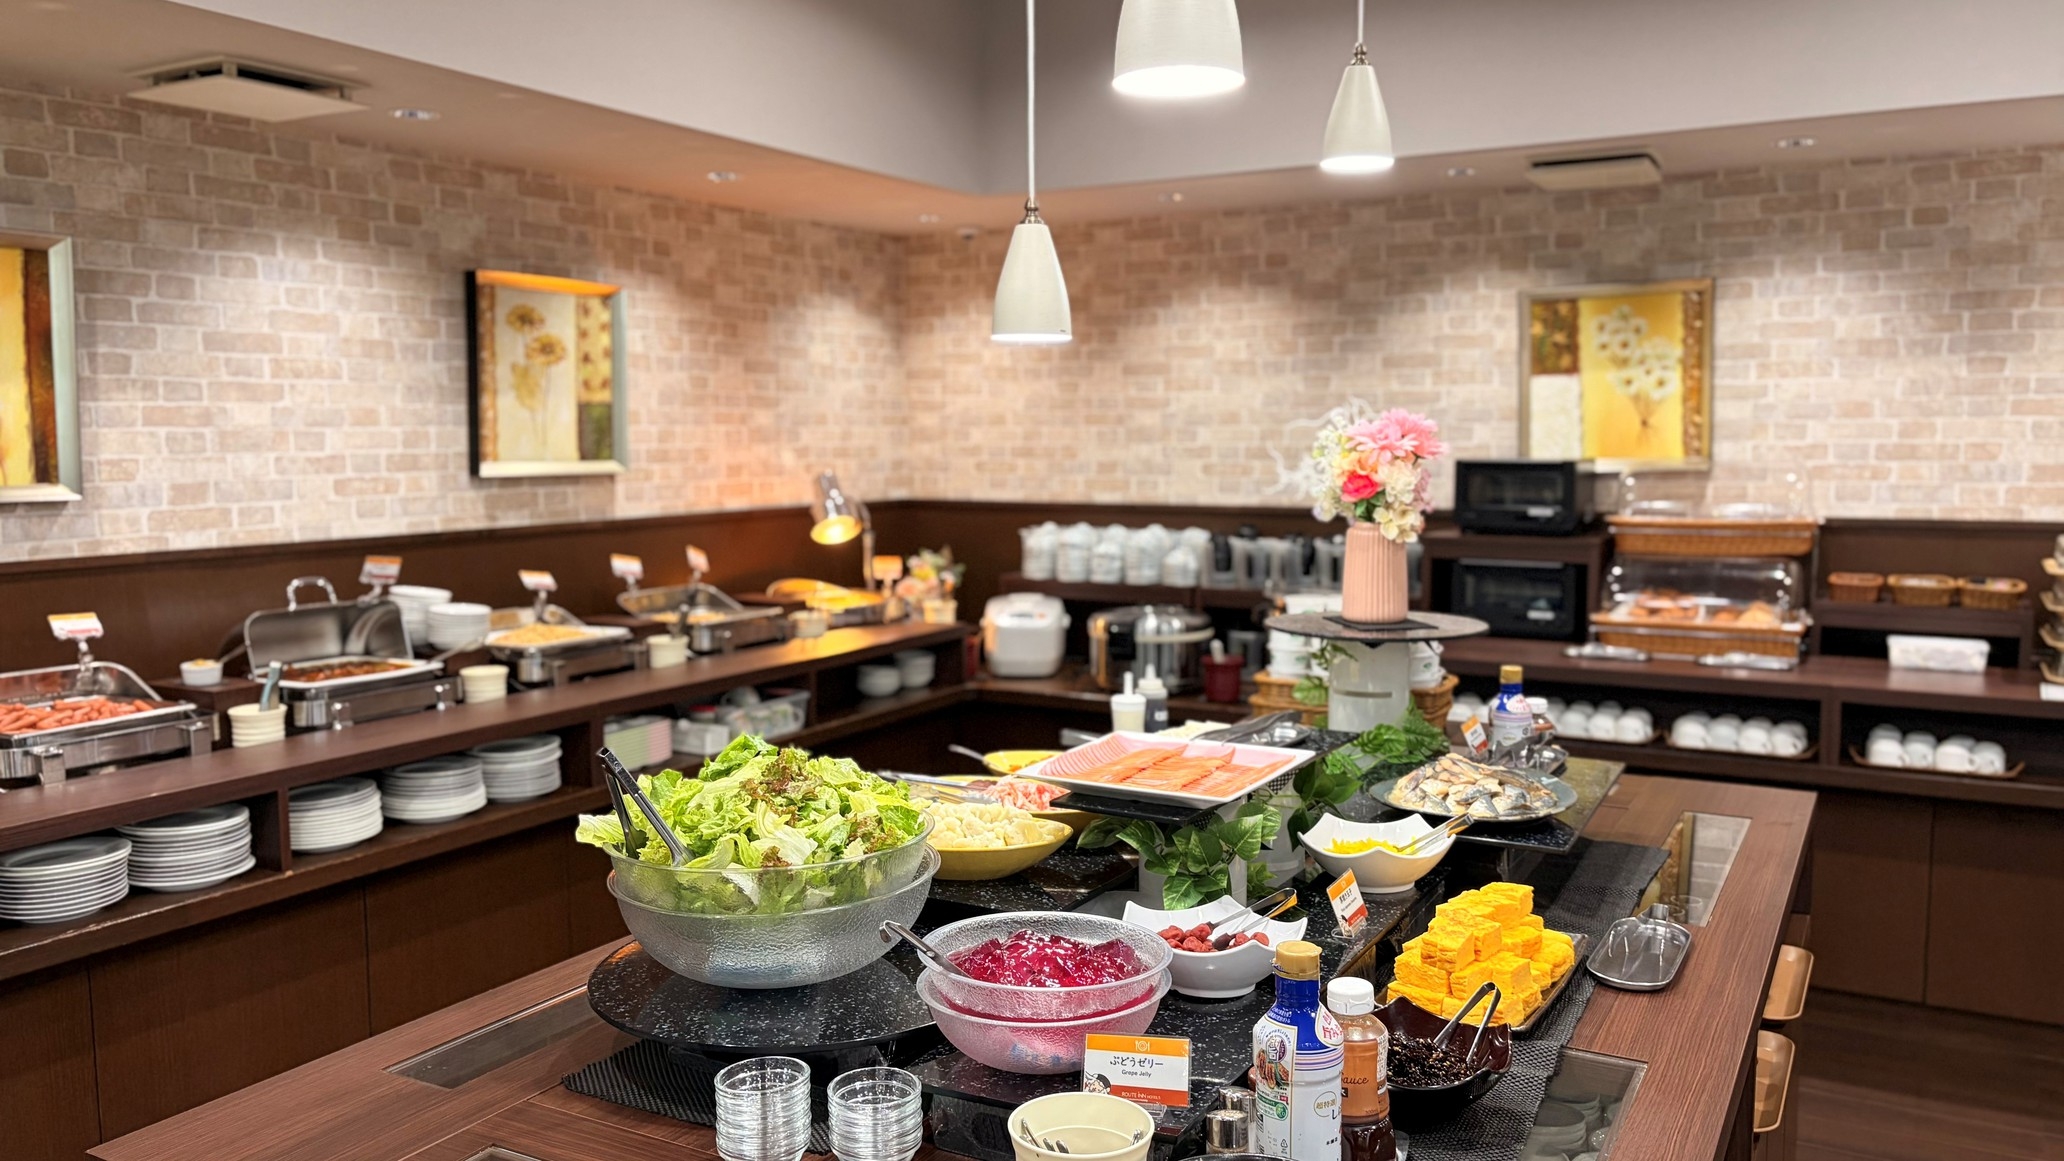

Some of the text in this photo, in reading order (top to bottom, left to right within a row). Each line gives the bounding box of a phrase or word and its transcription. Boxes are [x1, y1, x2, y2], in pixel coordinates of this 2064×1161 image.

[1110, 1056, 1163, 1068] ぶどうゼリー
[1139, 1070, 1152, 1078] Jelly
[1121, 1091, 1137, 1099] ROUTE
